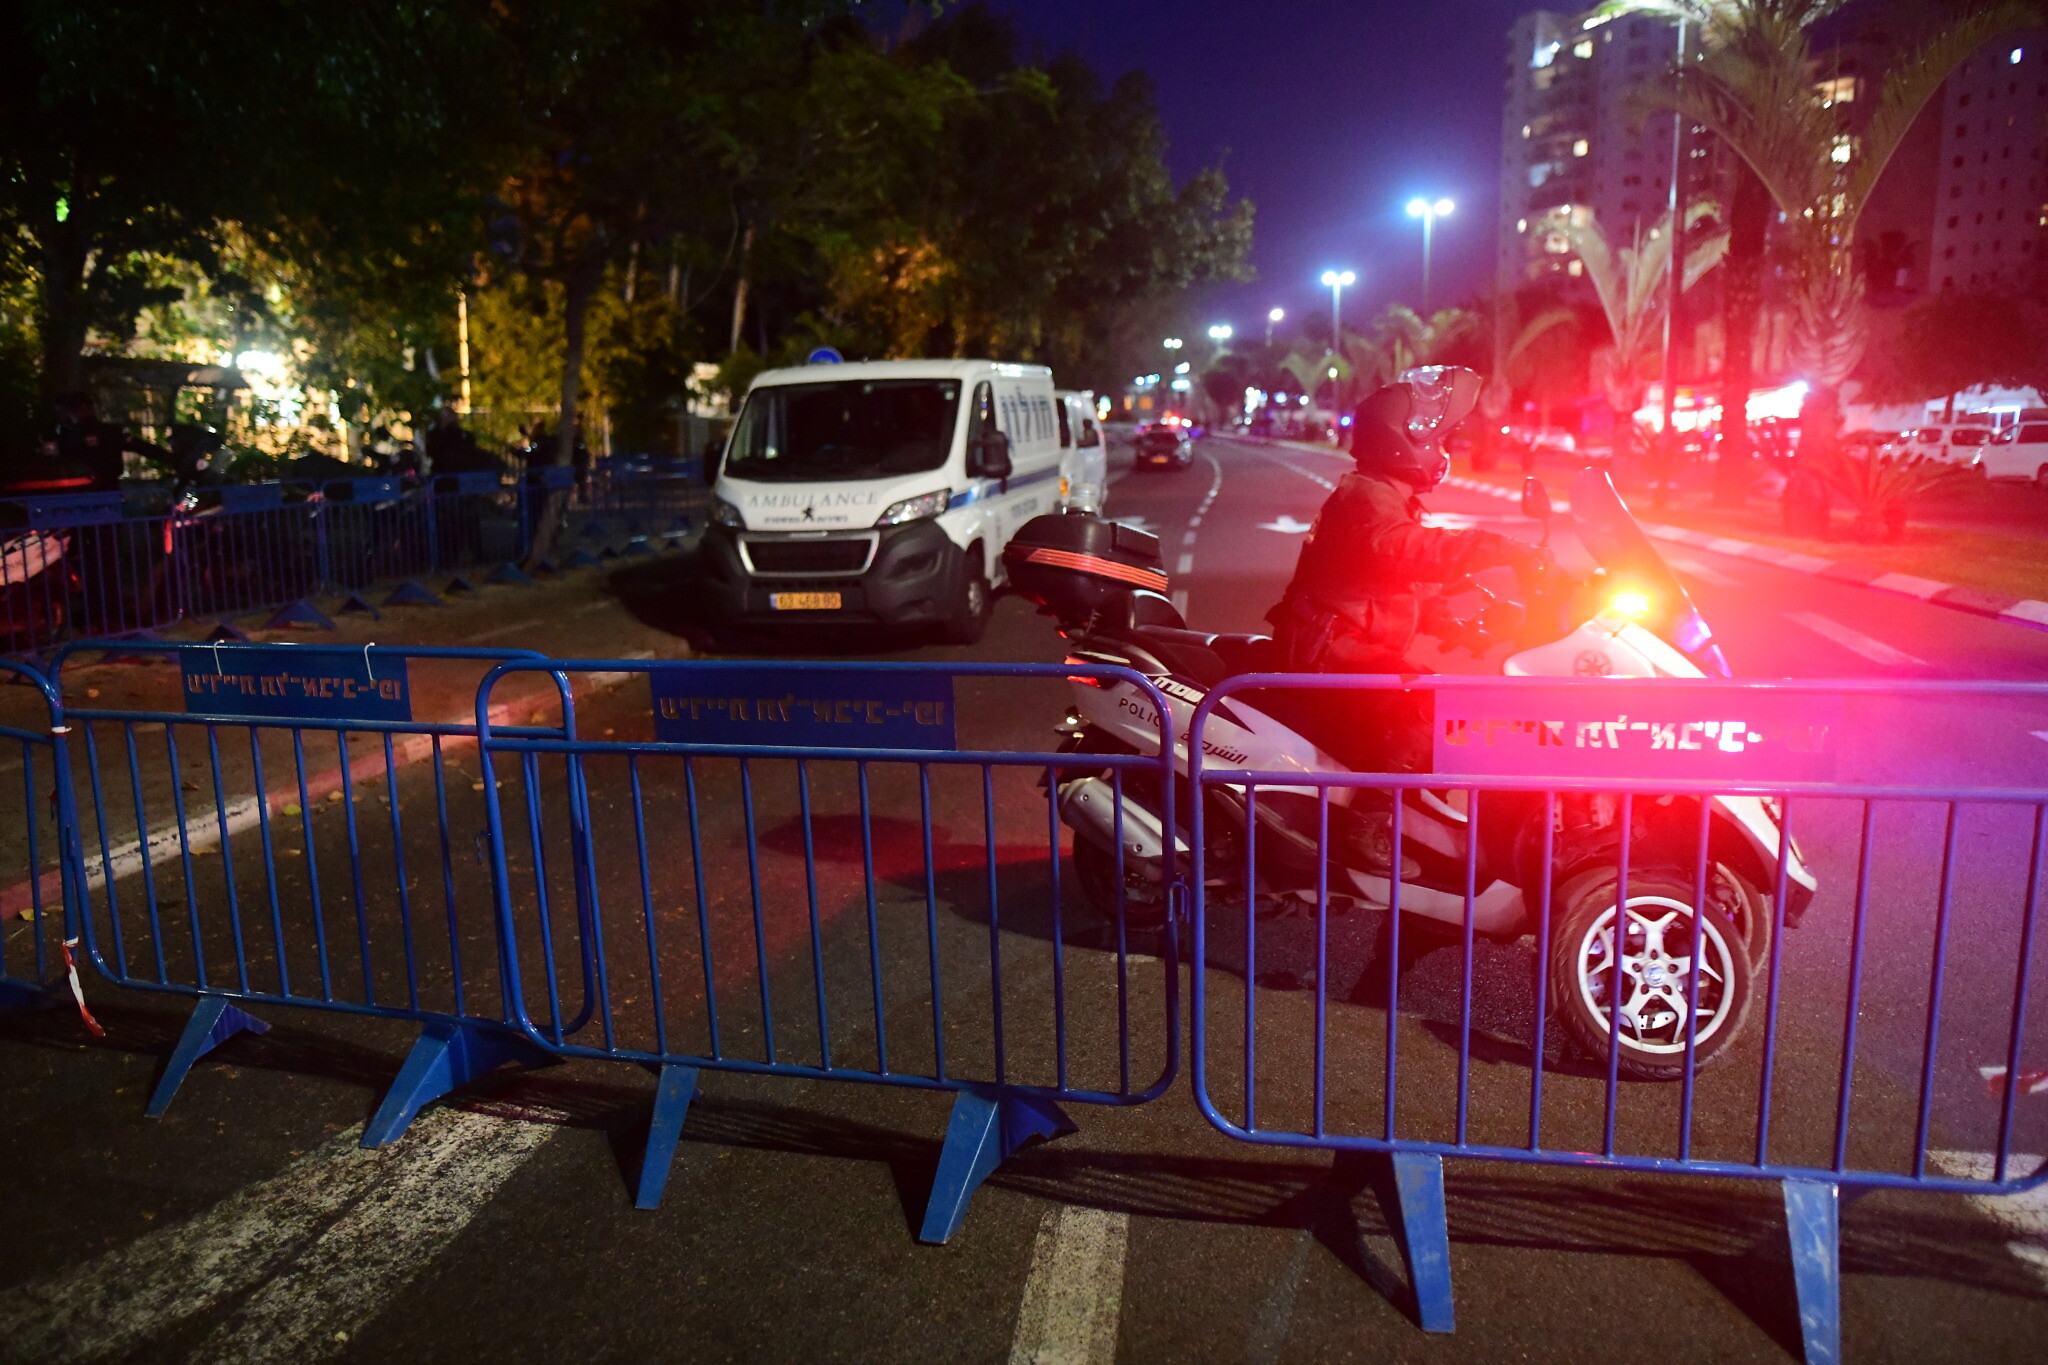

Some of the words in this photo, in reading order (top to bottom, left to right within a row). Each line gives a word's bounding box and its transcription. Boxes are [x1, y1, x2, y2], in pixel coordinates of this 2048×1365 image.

[748, 492, 878, 508] AMBULANCE
[1153, 677, 1205, 705] שטרה
[1119, 697, 1161, 727] POLIC
